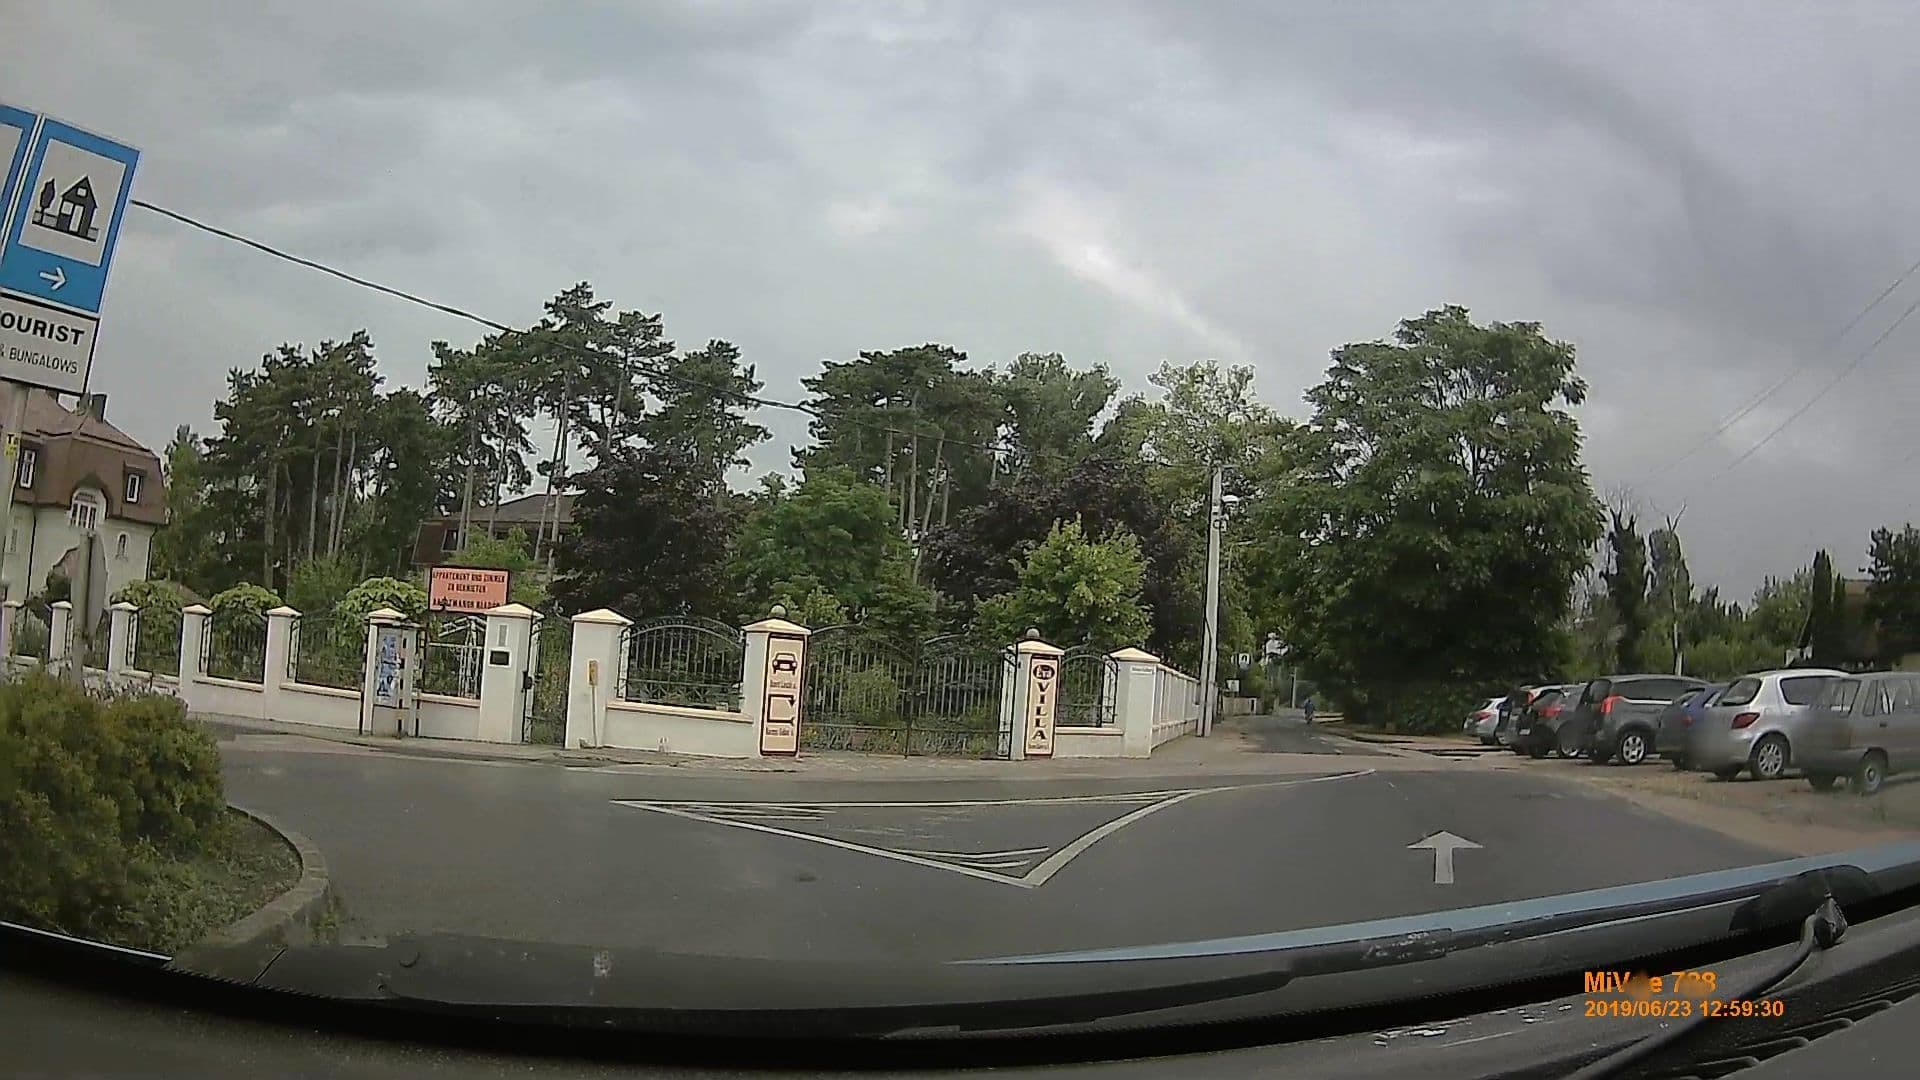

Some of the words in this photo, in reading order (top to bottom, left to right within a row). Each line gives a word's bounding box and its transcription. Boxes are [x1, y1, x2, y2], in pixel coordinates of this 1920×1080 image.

[0, 310, 85, 346] OURIST
[9, 347, 78, 374] BUNGALOWS
[1032, 681, 1051, 740] VILLA
